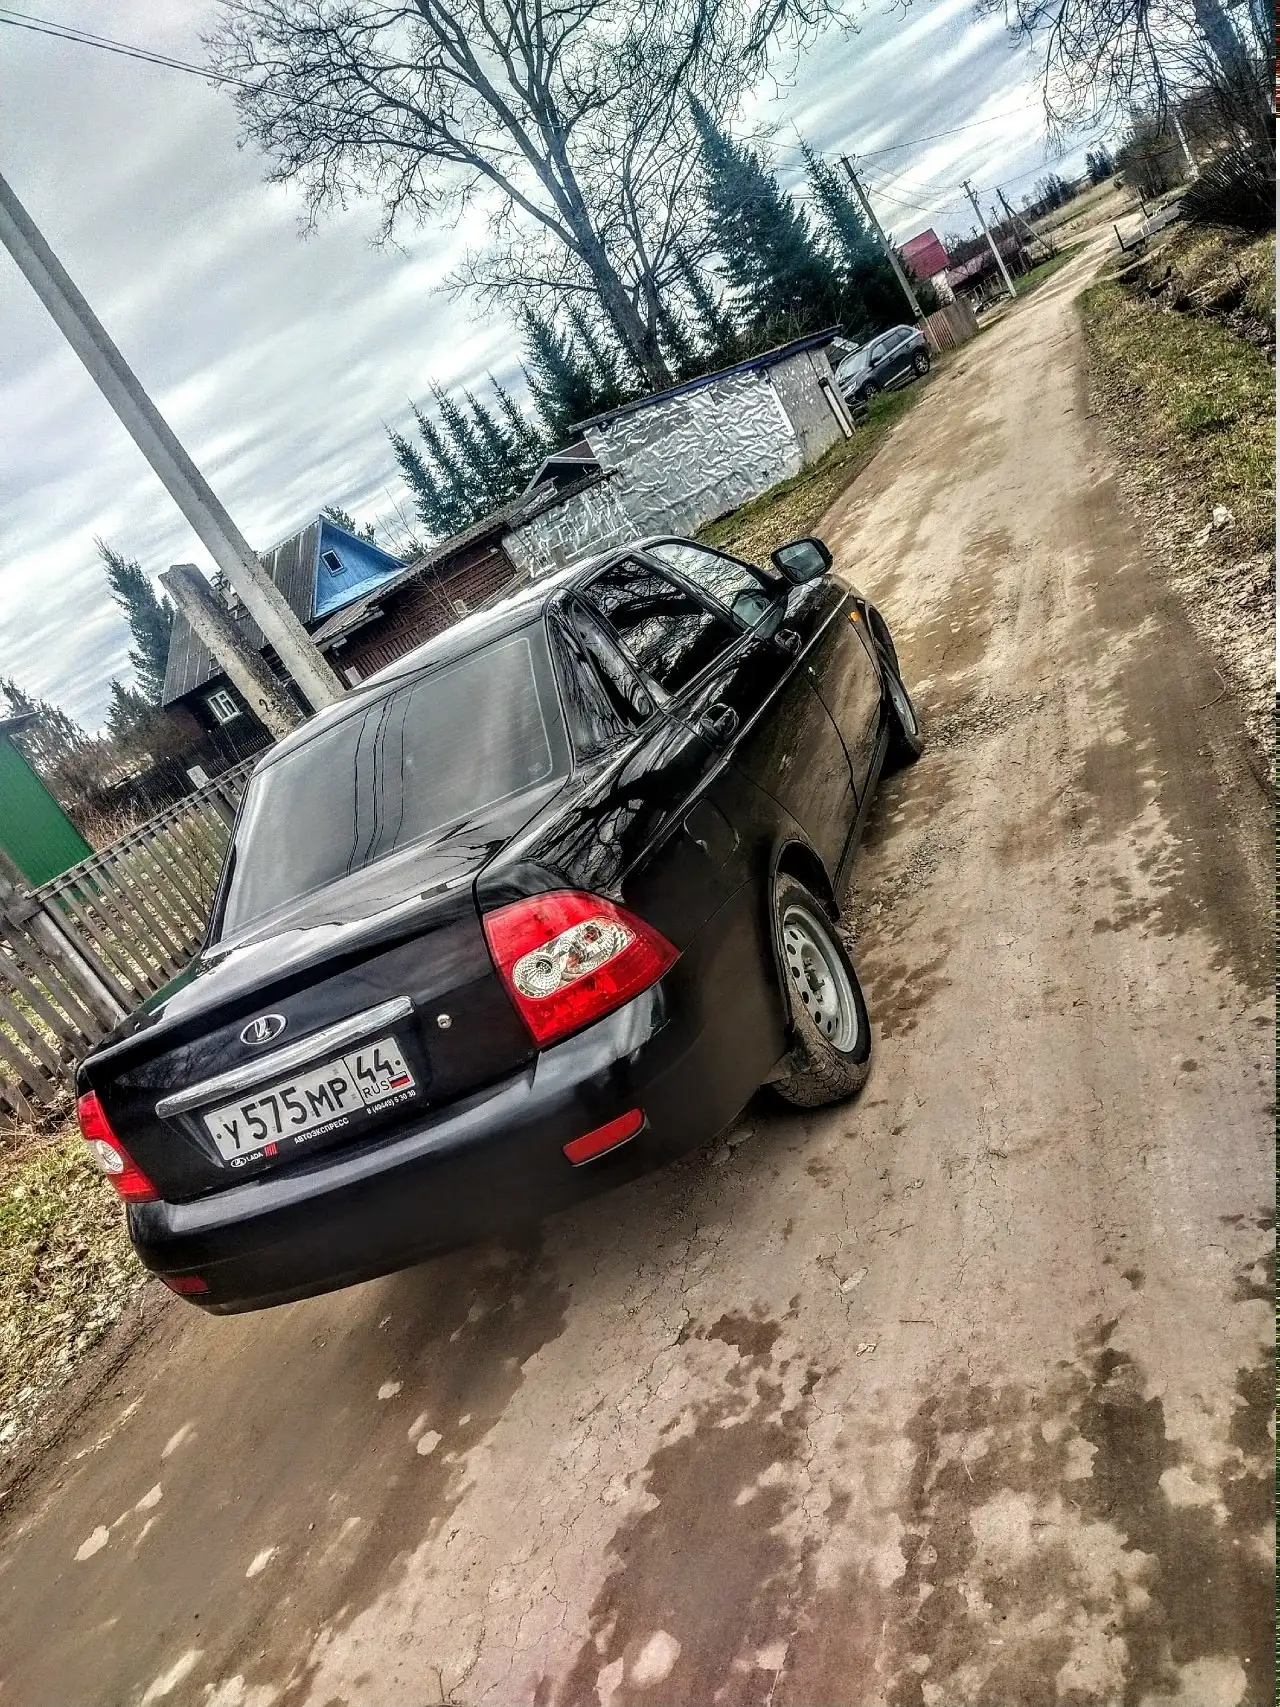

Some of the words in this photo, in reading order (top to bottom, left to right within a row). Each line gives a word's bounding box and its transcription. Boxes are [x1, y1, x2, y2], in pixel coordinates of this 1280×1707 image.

[356, 1048, 395, 1083] 44
[362, 1080, 390, 1099] RUS
[294, 1117, 350, 1145] АВТОЭКСПРЕСС
[246, 1151, 264, 1162] LADA
